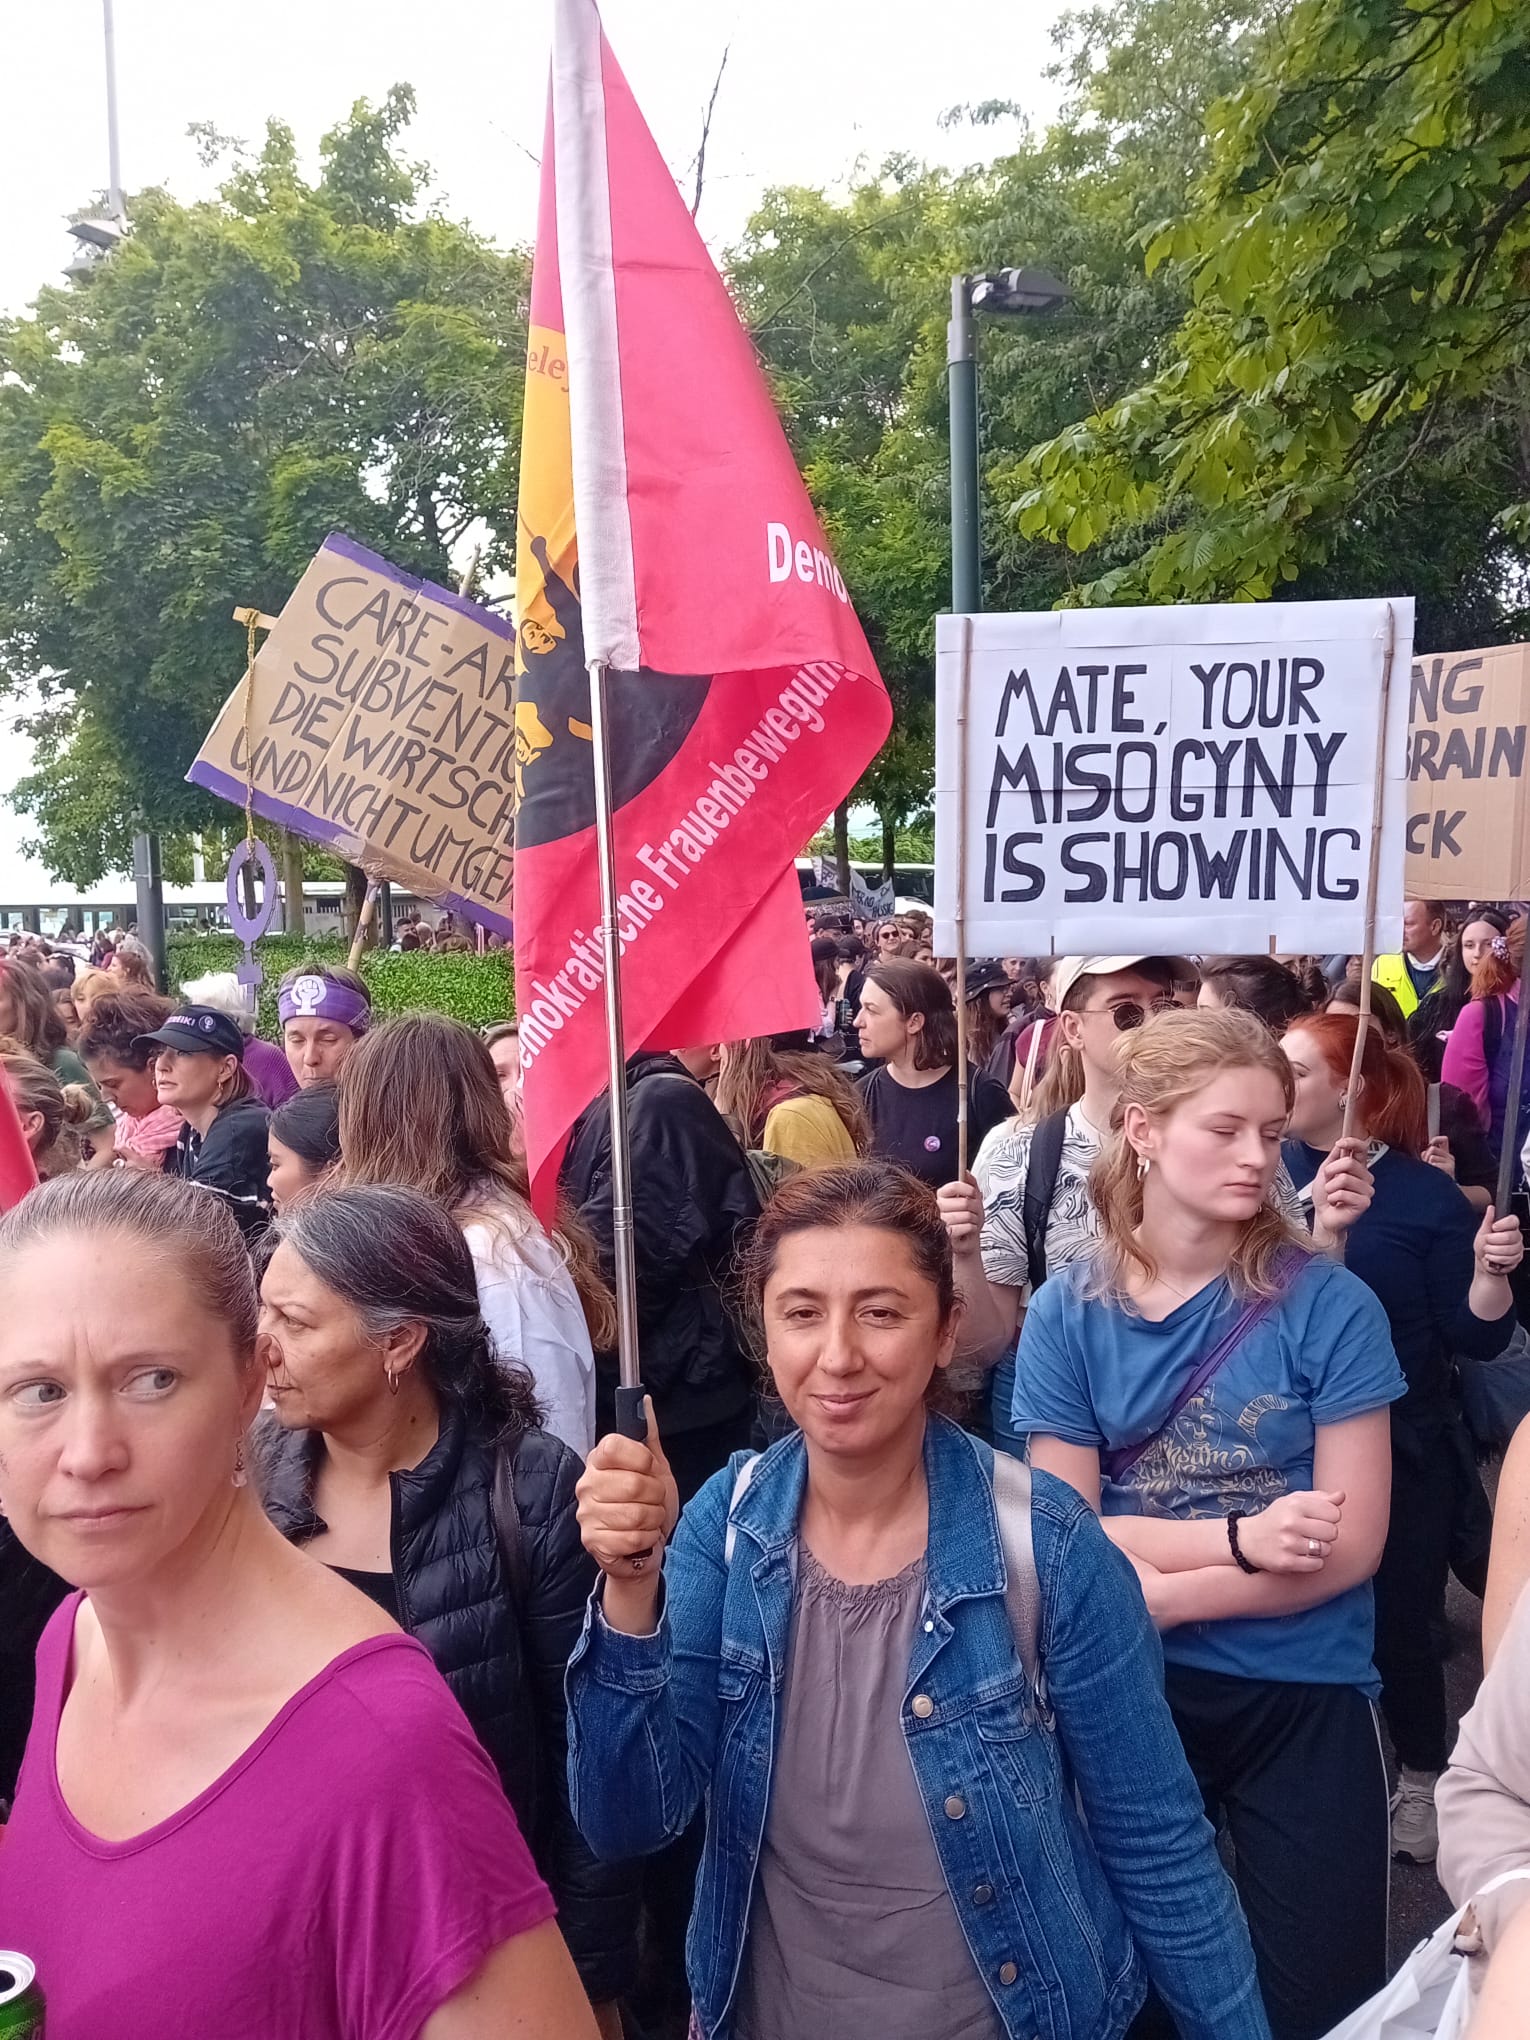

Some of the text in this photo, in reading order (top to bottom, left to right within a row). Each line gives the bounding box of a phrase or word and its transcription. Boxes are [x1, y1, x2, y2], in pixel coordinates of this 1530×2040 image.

[767, 522, 854, 609] Demo
[316, 577, 516, 713] CARE-AR
[996, 657, 1325, 737] MATE, YOUR
[230, 727, 312, 793] UND
[302, 770, 423, 847] NICHT
[269, 681, 515, 846] DIE WIRTSCH
[636, 662, 859, 890] Frauenbewegun
[986, 732, 1347, 828] MISOGYNY
[1405, 725, 1528, 781] RAIN
[984, 827, 1361, 903] IS SHOWING
